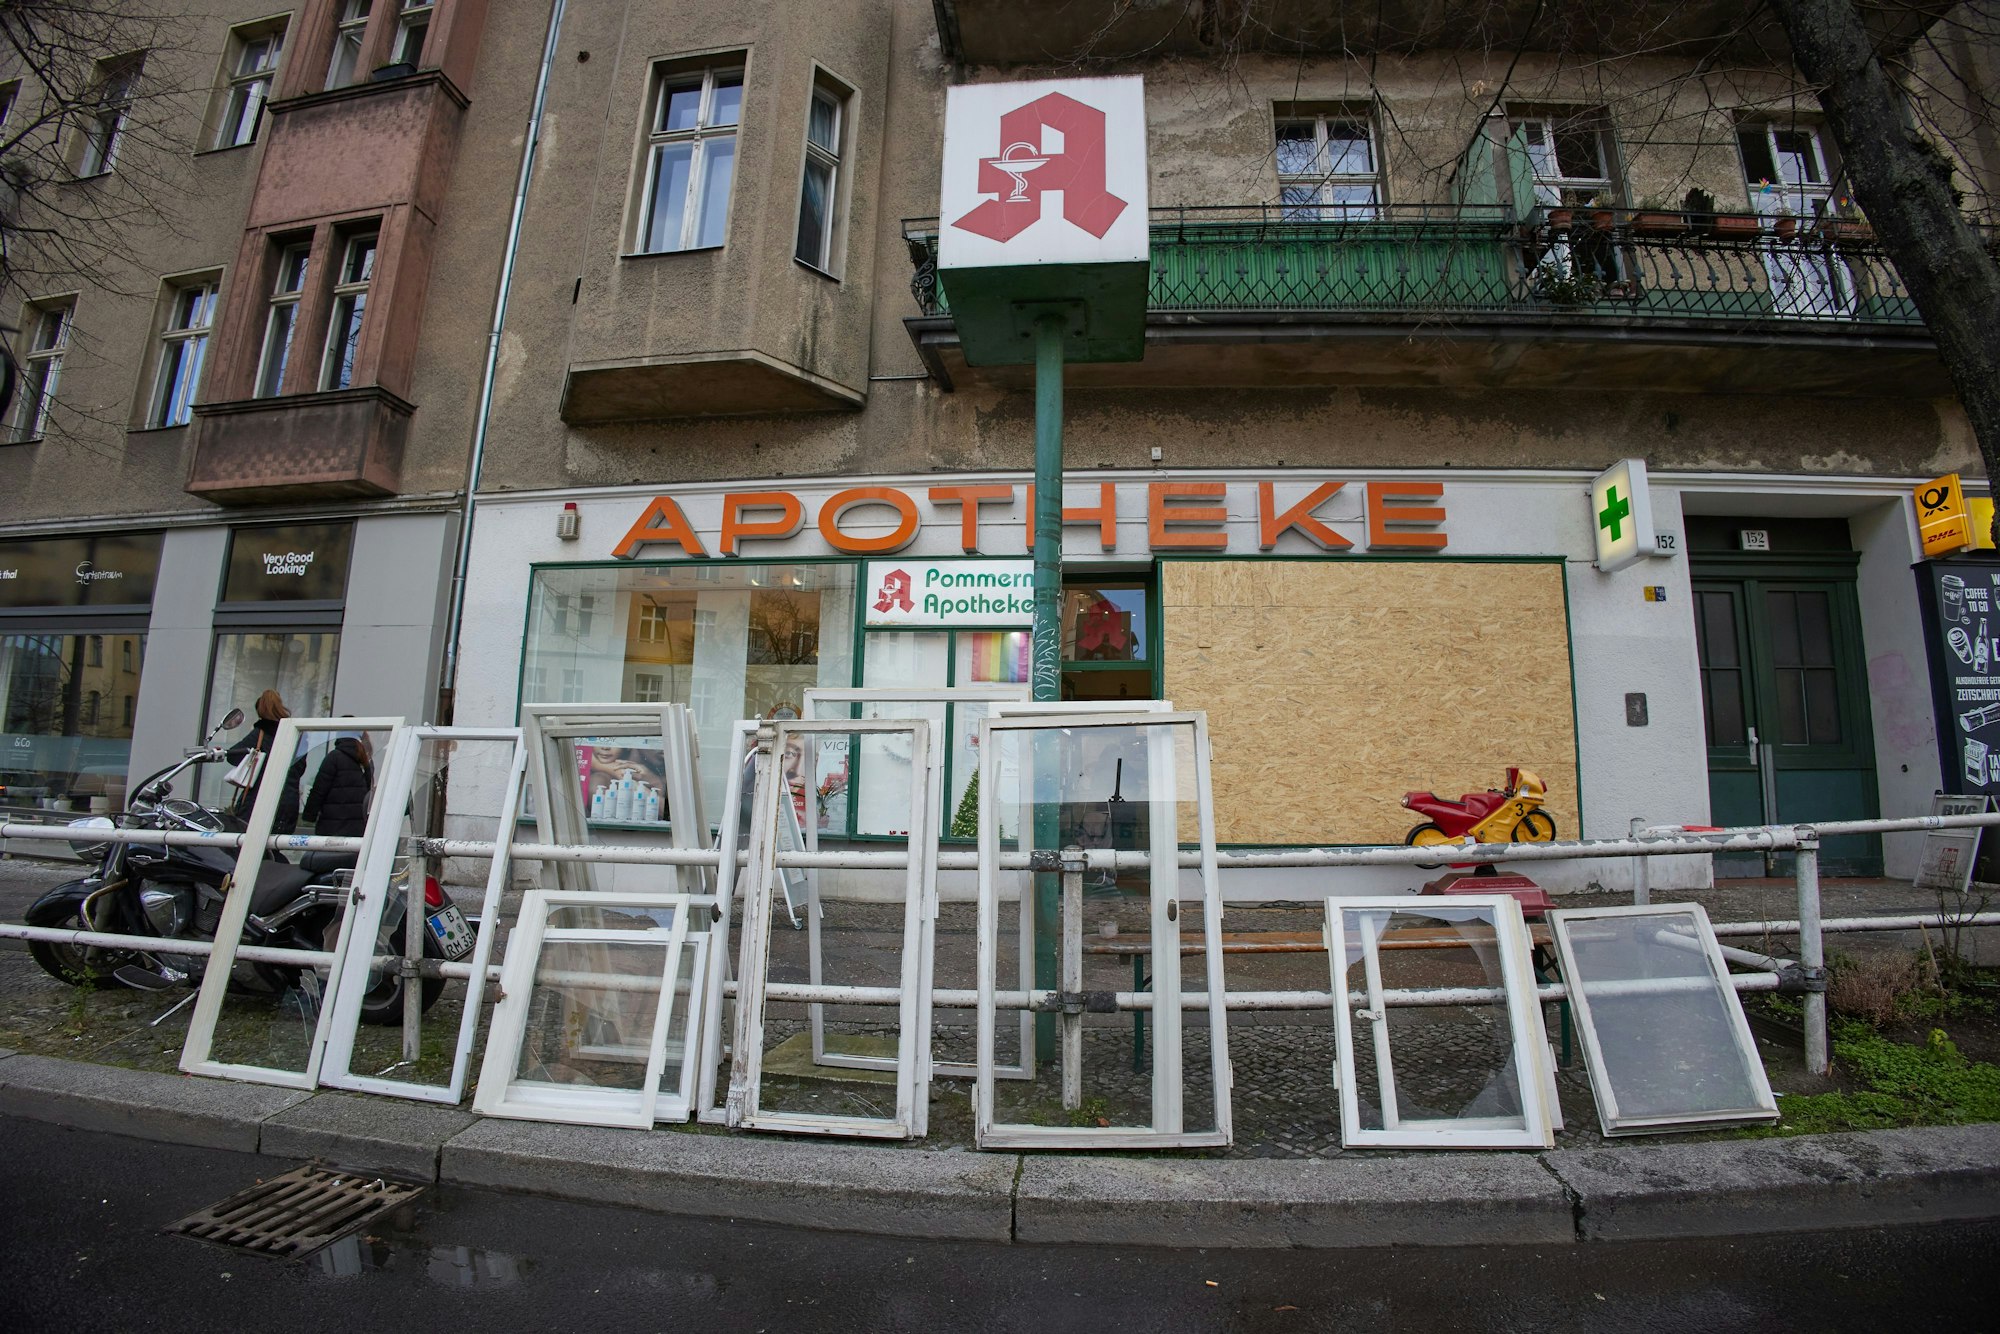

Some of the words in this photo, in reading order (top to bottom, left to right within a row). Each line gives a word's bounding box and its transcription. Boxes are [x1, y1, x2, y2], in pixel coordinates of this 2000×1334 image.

[611, 482, 1448, 560] APOTHEKE
[1656, 535, 1675, 549] 152
[1745, 532, 1765, 544] 152
[1927, 529, 1957, 543] DHL
[263, 553, 286, 566] Very
[286, 552, 314, 563] Good
[266, 563, 306, 576] Looking
[925, 568, 1034, 588] Pommern
[1965, 588, 1988, 599] COFFEE
[923, 594, 1034, 619] Apotheke
[1968, 601, 1978, 612] TO
[1979, 601, 1988, 612] GO
[1515, 803, 1524, 816] 3
[446, 911, 454, 923] B
[446, 940, 463, 957] RM
[461, 933, 474, 946] 33
